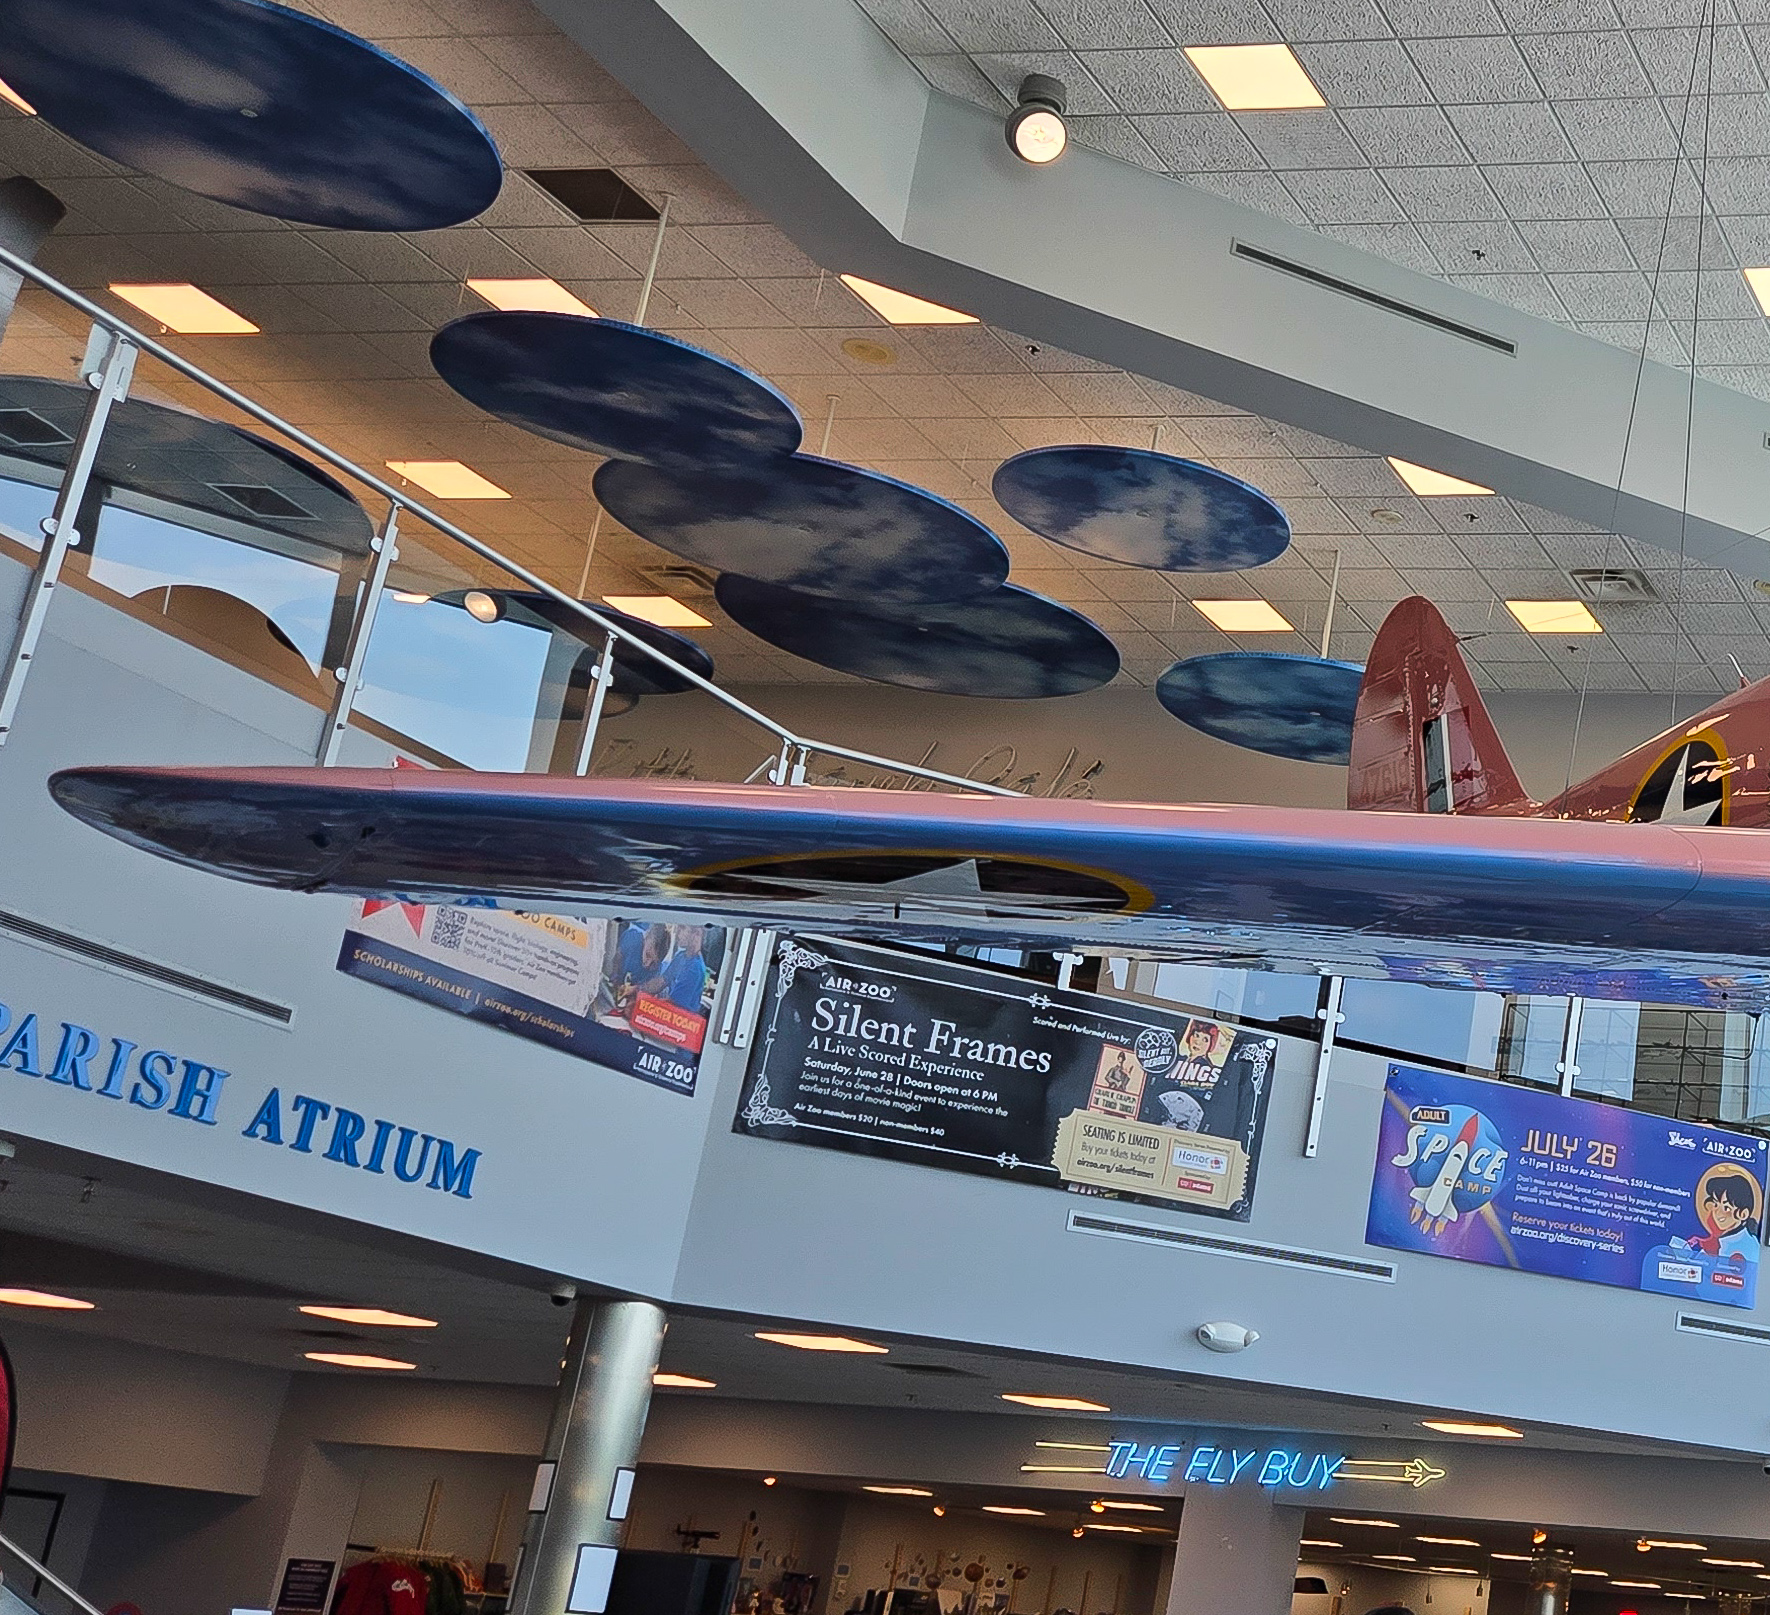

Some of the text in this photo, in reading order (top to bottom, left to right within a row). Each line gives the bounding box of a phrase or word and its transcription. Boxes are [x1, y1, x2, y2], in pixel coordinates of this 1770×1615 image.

[544, 915, 578, 942] CAMPS
[353, 949, 425, 983] SCHOLARSHIPS
[424, 975, 472, 1000] AVAILABLE
[483, 998, 576, 1039] airzoo.org/scholarships
[825, 977, 852, 992] AIR
[860, 982, 892, 998] ZOO
[639, 999, 700, 1034] REGISTER TODAY!
[1032, 1016, 1057, 1027] Scored
[1057, 1021, 1071, 1030] and
[1071, 1024, 1106, 1038] Performed
[1106, 1032, 1119, 1041] Live
[811, 997, 1052, 1073] Silent Frames
[639, 1052, 662, 1073] AIR
[665, 1058, 693, 1084] ZOO
[807, 1035, 985, 1082] A Live Scored Experience
[800, 1070, 818, 1081] Join
[819, 1076, 830, 1084] us
[831, 1076, 844, 1086] for
[852, 1079, 912, 1100] one-of-a-kind
[913, 1093, 936, 1104] event
[937, 1096, 946, 1105] to
[947, 1098, 993, 1116] experience
[994, 1107, 1008, 1116] the
[803, 1056, 998, 1102] Saturday, June 28 Doors open at 6 PM
[0, 1005, 484, 1200] ARISH ATRIUM
[798, 1082, 921, 1114] earliest days of movie magic!
[794, 1102, 806, 1111] Air
[807, 1104, 822, 1114] Zoo
[822, 1107, 856, 1120] members
[857, 1113, 873, 1124] $20
[930, 1126, 945, 1136] $40
[1417, 1110, 1446, 1121] ADULT
[1082, 1124, 1160, 1151] SEATING IS LIMITED
[1520, 1129, 1618, 1168] JULY 26
[1706, 1142, 1752, 1159] AIR ZOO
[1080, 1142, 1156, 1165] Buy your tickets today at
[1178, 1150, 1210, 1164] Honor
[1443, 1177, 1491, 1195] CAMP
[1555, 1162, 1569, 1174] $25
[1570, 1165, 1579, 1175] for
[1579, 1167, 1590, 1177] Air
[1589, 1168, 1602, 1180] Zoo
[1630, 1177, 1644, 1188] $50
[1643, 1180, 1652, 1190] for
[1510, 1225, 1625, 1255] airzoo.org/discovery-series
[1511, 1211, 1624, 1242] Reserve your tickets today!
[1662, 1264, 1687, 1275] Honor
[1104, 1441, 1346, 1490] THE FLY BUY
